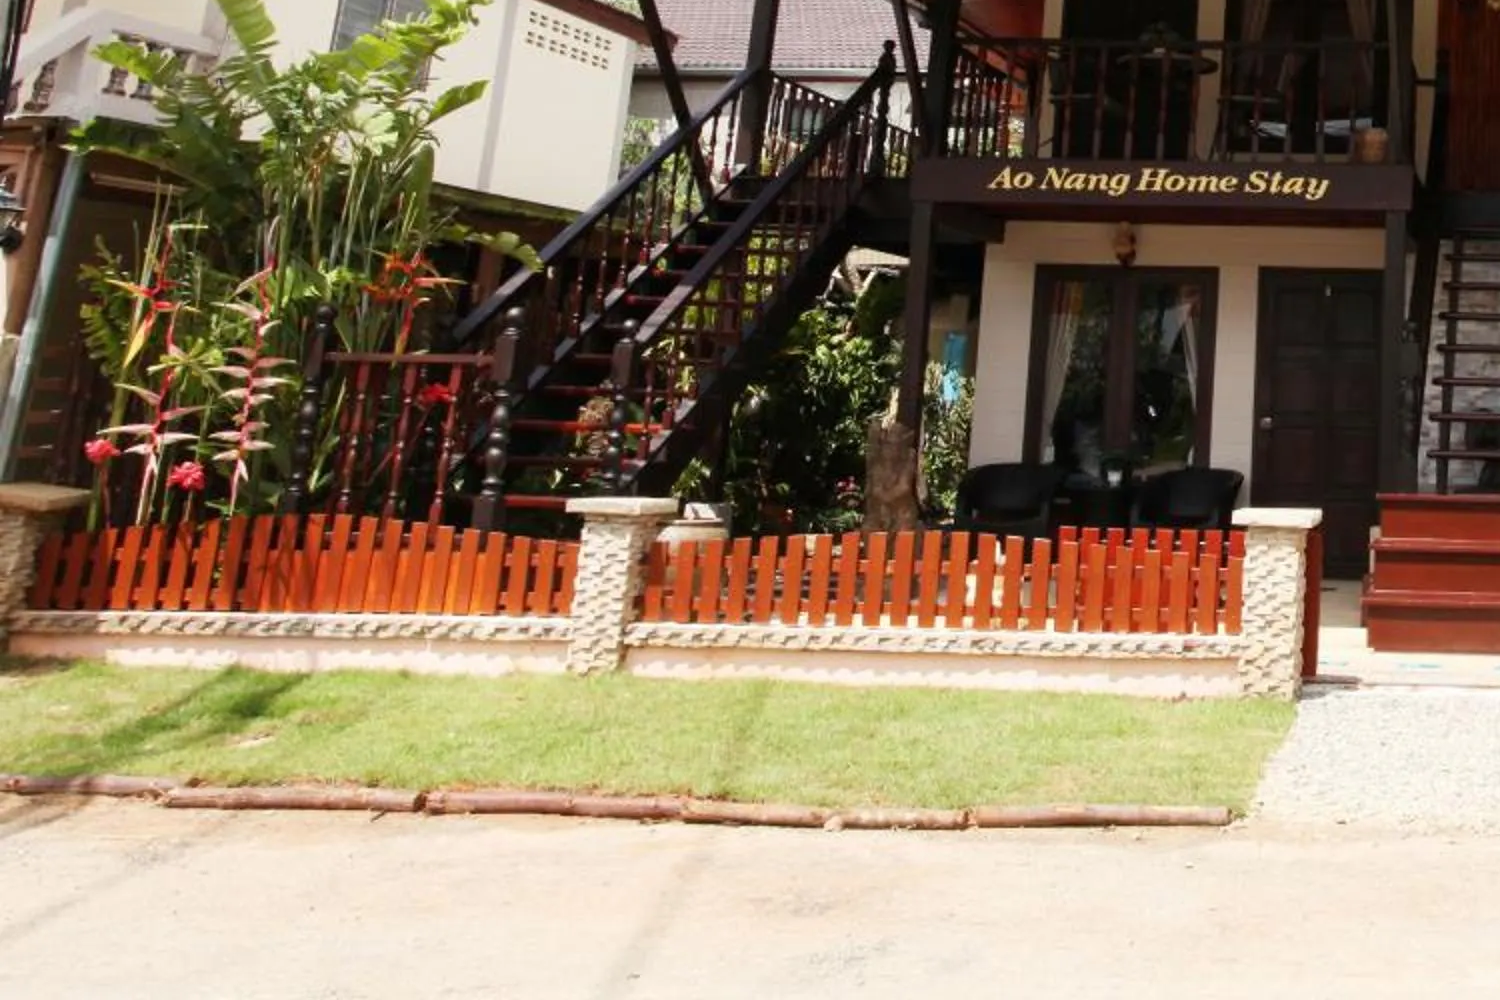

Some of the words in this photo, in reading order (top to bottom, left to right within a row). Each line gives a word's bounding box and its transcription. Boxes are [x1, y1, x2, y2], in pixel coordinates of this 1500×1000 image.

[987, 165, 1034, 190] Ao
[1039, 167, 1131, 197] Nang
[1135, 167, 1239, 193] Home
[1243, 170, 1330, 201] Stay
